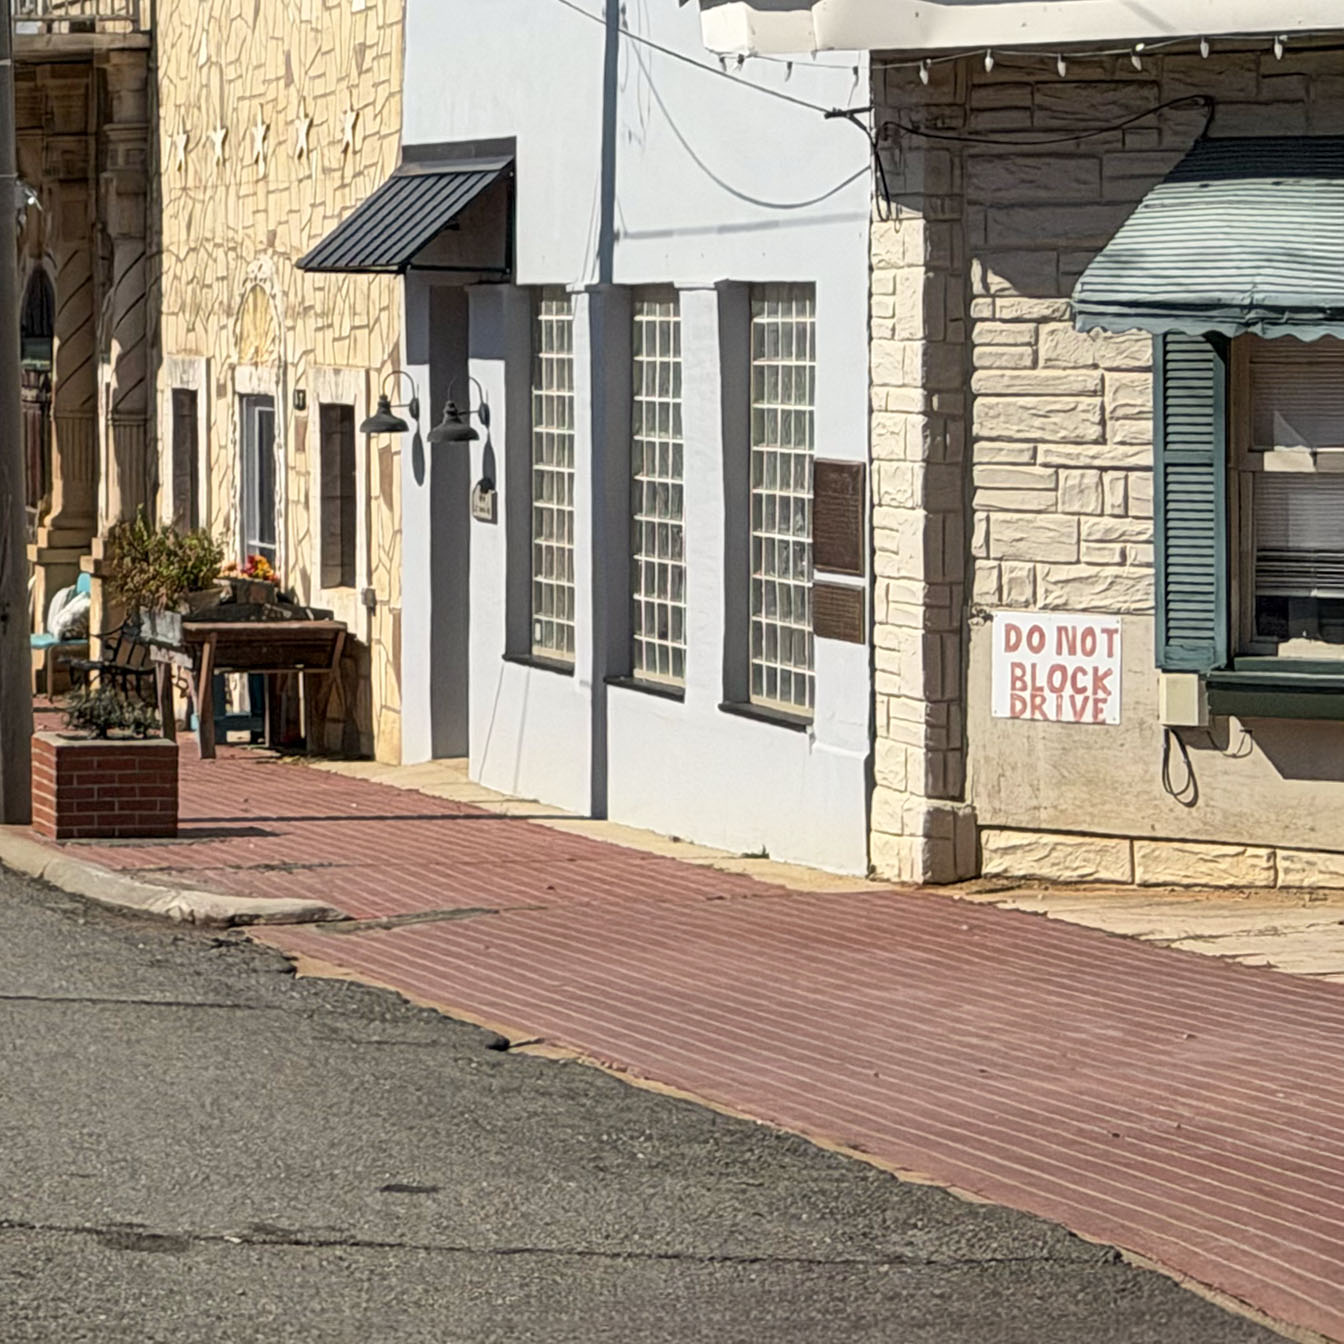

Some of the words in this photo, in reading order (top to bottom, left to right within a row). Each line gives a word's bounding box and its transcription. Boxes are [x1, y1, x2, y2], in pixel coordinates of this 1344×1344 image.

[1004, 623, 1046, 654] DO
[1056, 626, 1119, 658] NOT
[1010, 661, 1113, 696] BLOCK
[1009, 692, 1108, 725] DRIVE
